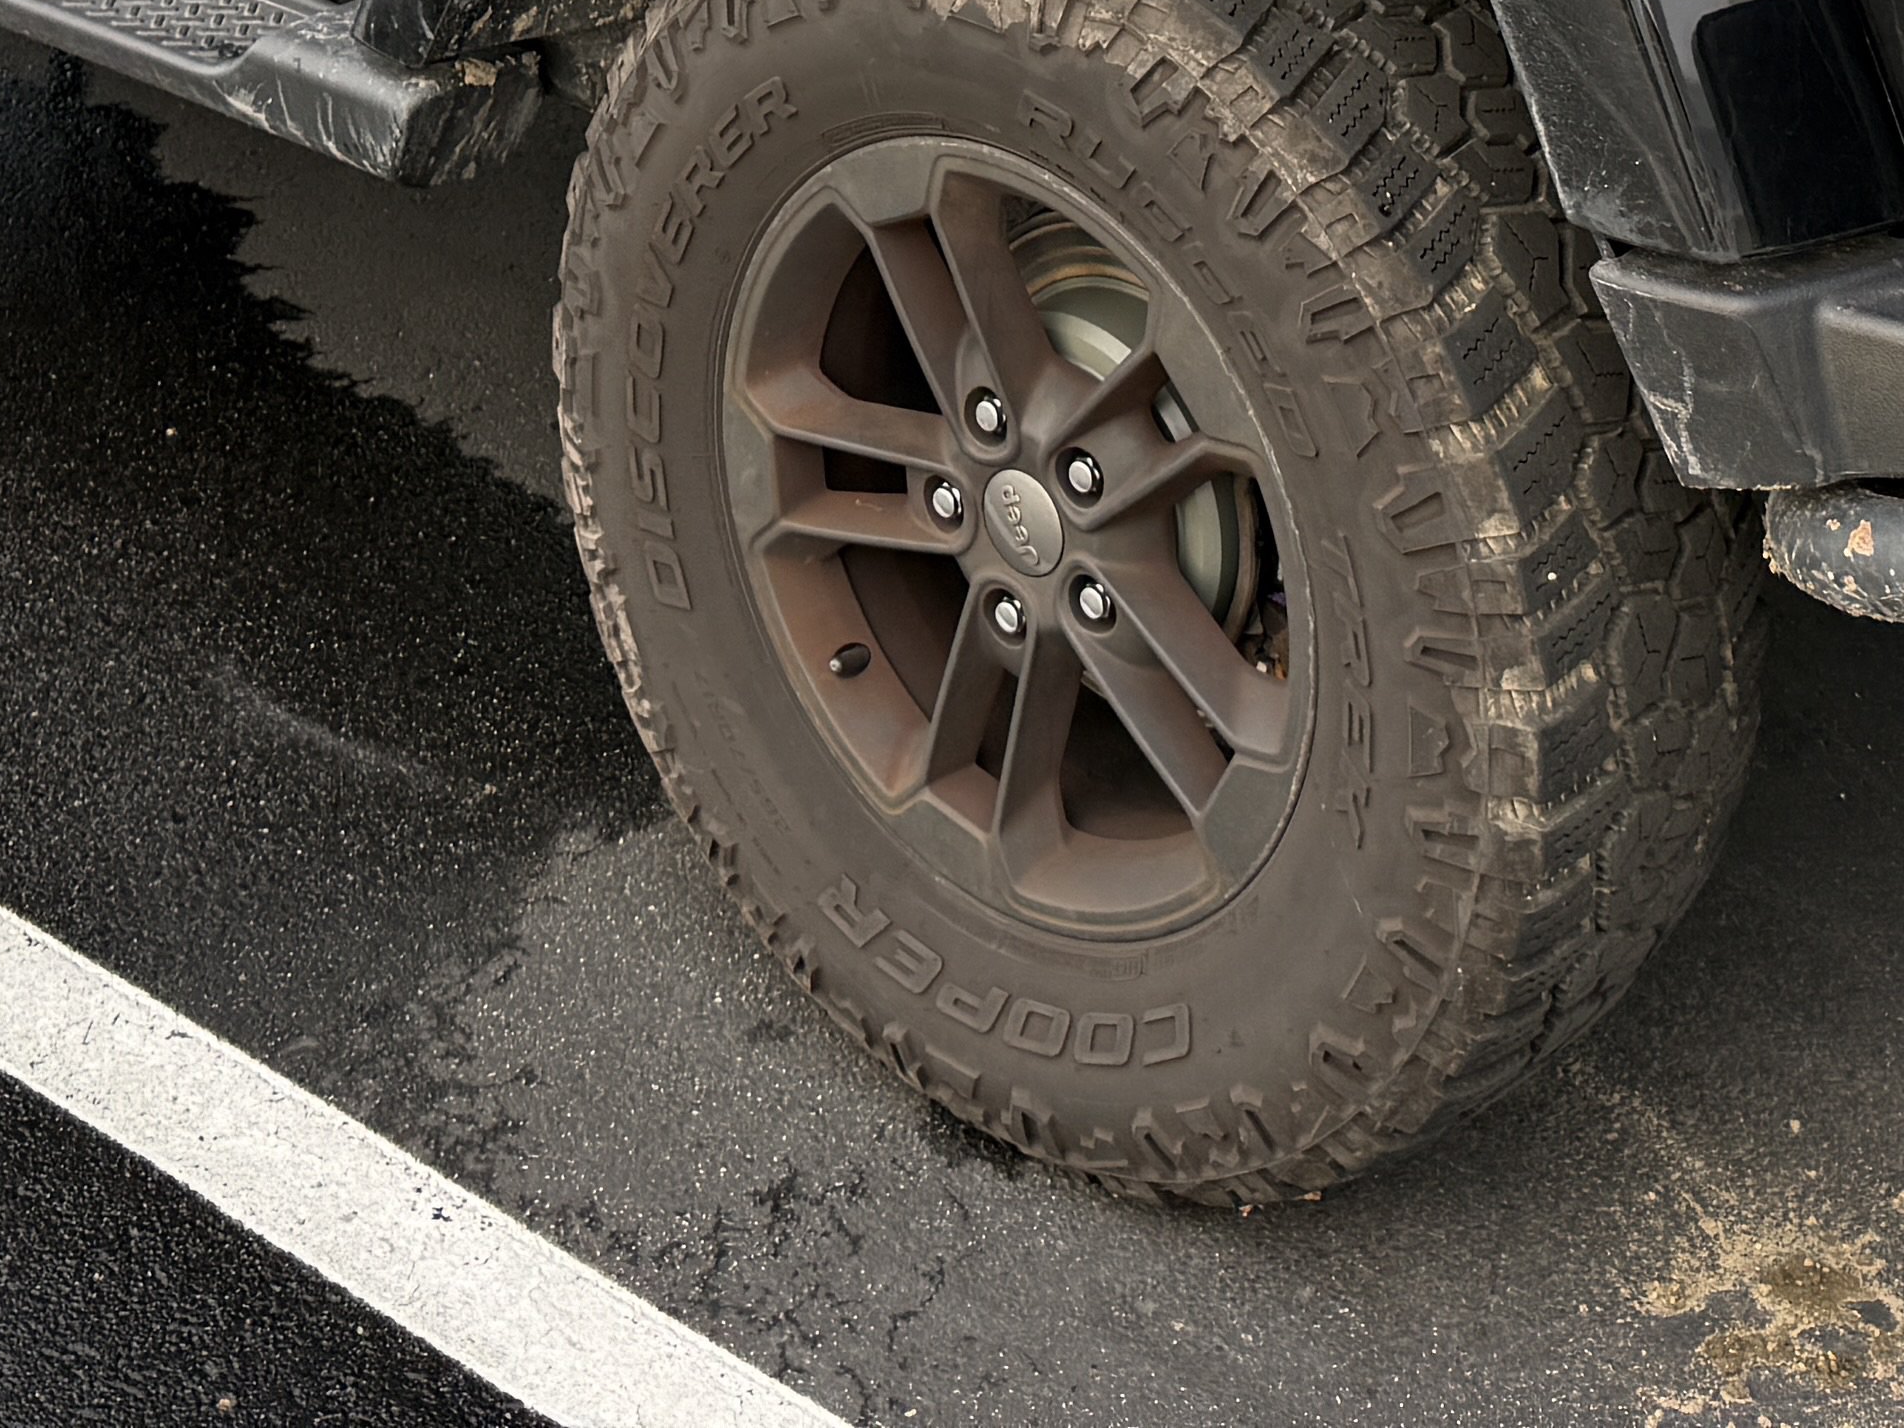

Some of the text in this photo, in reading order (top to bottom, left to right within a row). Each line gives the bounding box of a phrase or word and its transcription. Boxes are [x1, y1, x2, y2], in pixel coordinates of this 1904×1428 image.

[626, 75, 799, 611] DISCOVERER
[1000, 483, 1041, 566] Jeep
[1016, 88, 1375, 850] RUGGED TREK
[816, 872, 1193, 1068] COOPER
